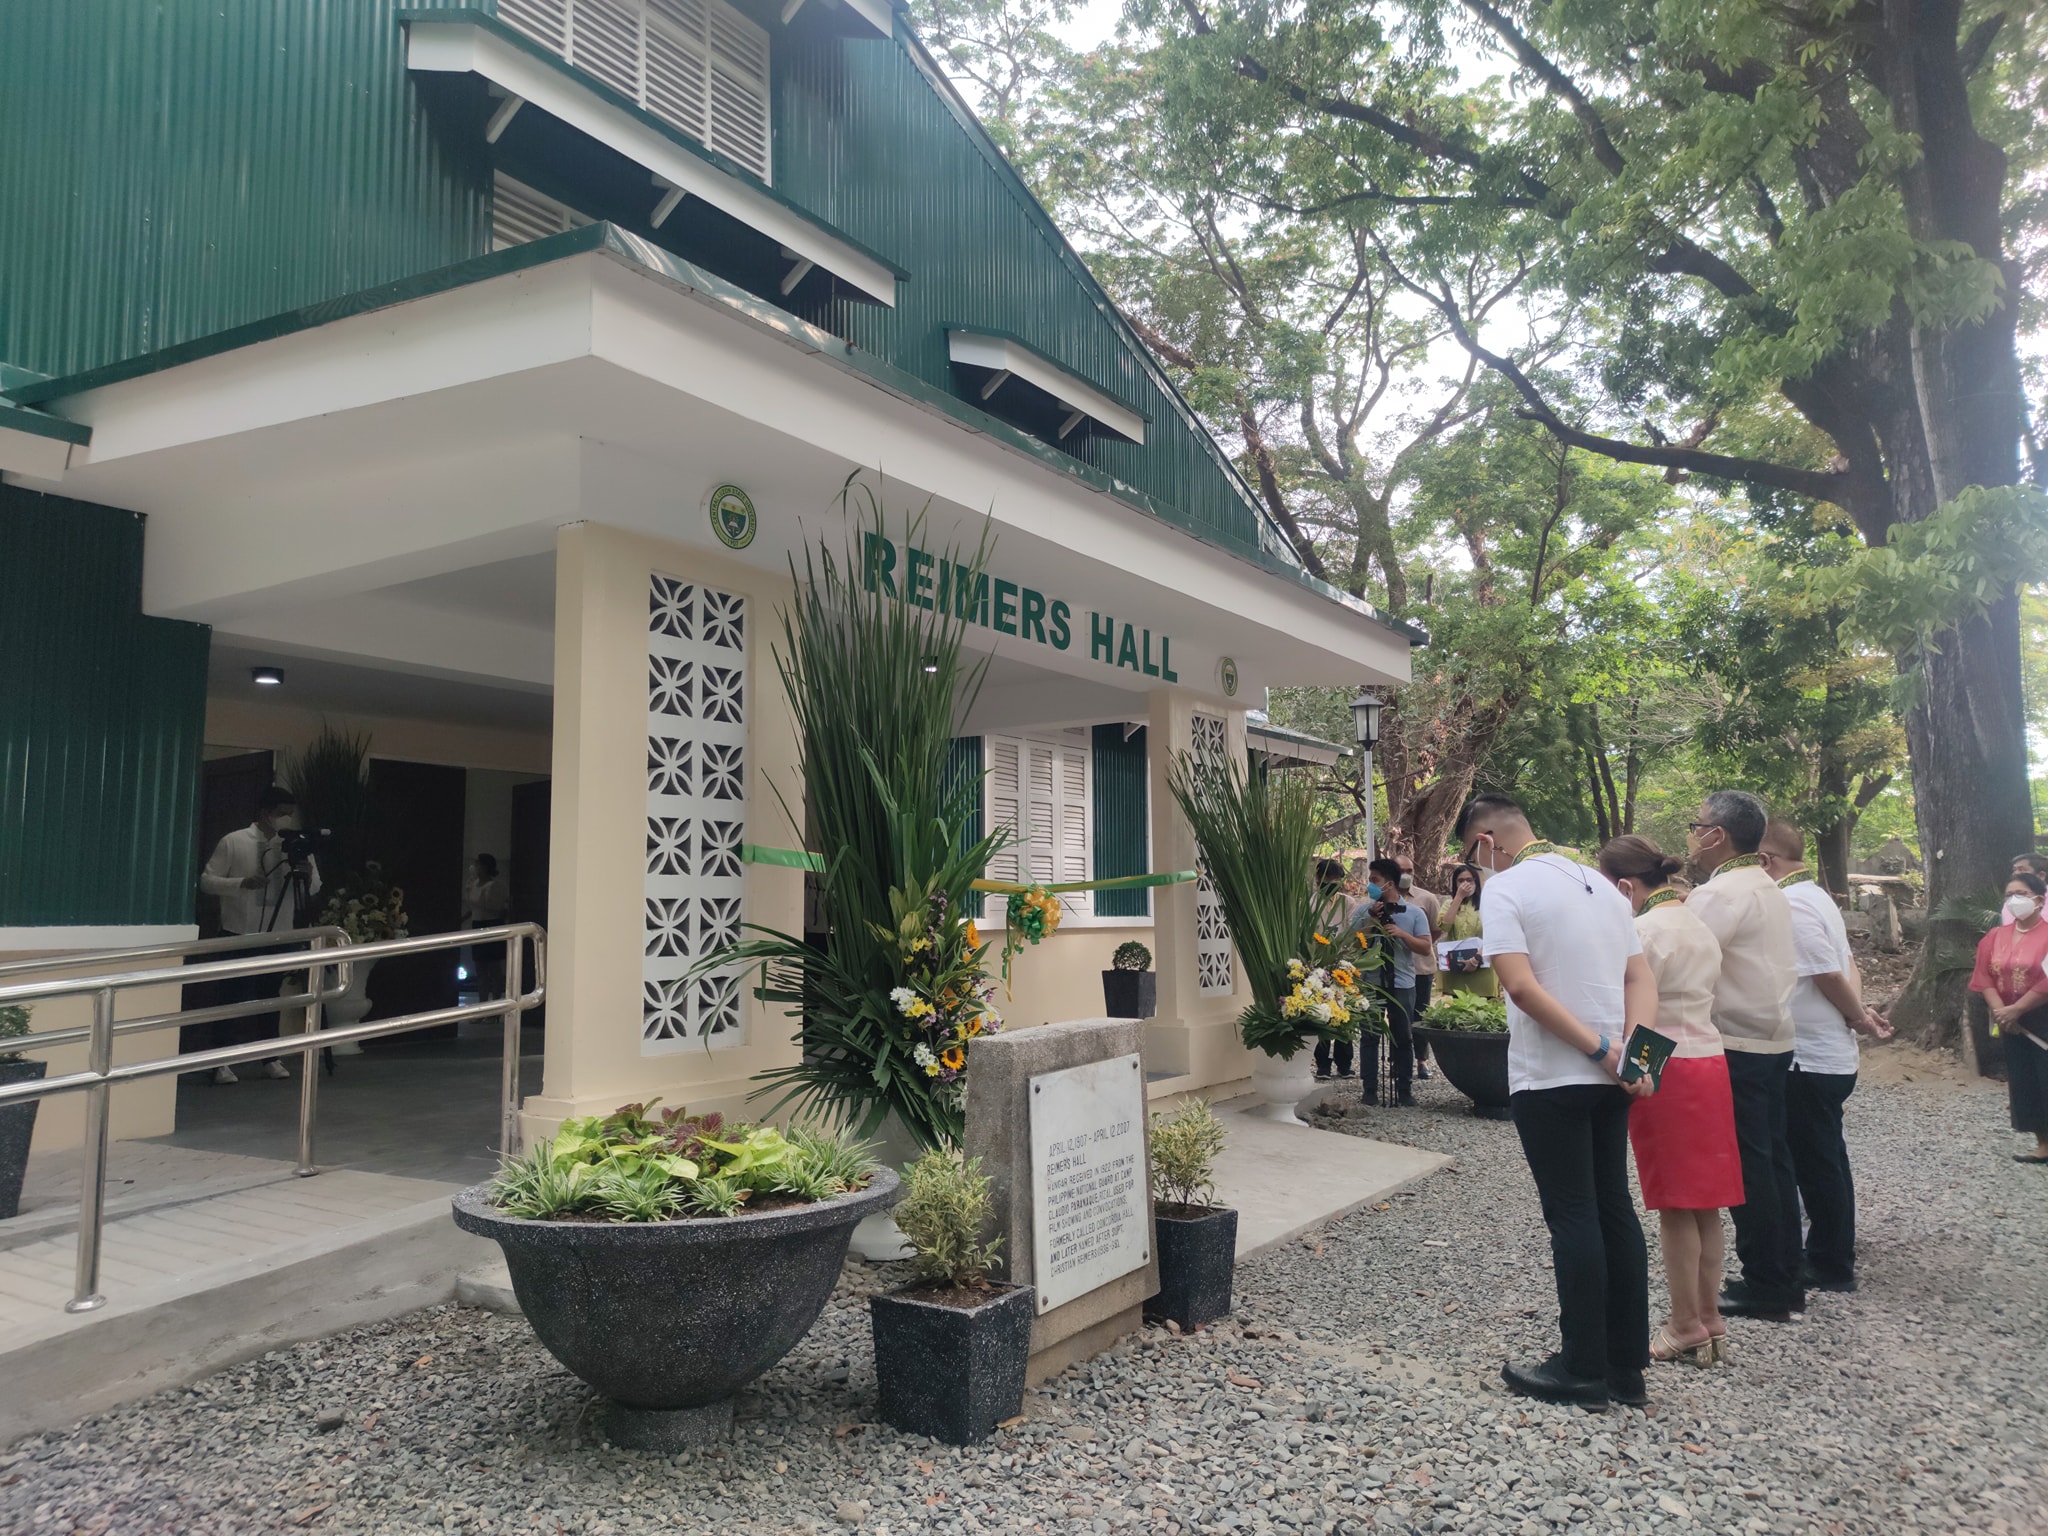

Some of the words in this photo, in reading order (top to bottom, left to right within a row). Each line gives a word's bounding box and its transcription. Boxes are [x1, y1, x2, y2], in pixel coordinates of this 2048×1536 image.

[864, 531, 1071, 650] REIMERS
[1091, 611, 1178, 683] HALL
[1049, 1141, 1066, 1157] APRIL
[1094, 1127, 1109, 1142] APRIL
[1072, 1153, 1086, 1167] HALL
[1047, 1177, 1068, 1192] HANGAR
[1069, 1168, 1093, 1185] RECEIVED
[1093, 1167, 1099, 1177] IN
[1112, 1158, 1125, 1169] FROM
[1125, 1153, 1134, 1165] THE
[1048, 1188, 1075, 1207] PHILIPPINE
[1076, 1180, 1097, 1195] NATIONAL
[1098, 1174, 1113, 1188] GUARD
[1114, 1171, 1120, 1182] AT
[1121, 1167, 1133, 1180] CAMP
[1048, 1203, 1069, 1220] CLAUDIO
[1125, 1179, 1134, 1190] FOR
[1048, 1221, 1060, 1234] FILM
[1061, 1212, 1082, 1229] SHOWING
[1083, 1208, 1092, 1220] AND
[1049, 1229, 1075, 1249] FORMERLY
[1076, 1222, 1096, 1239] CALLED
[1096, 1212, 1122, 1230] CONCORDIA
[1123, 1208, 1134, 1218] HALL
[1050, 1250, 1061, 1264] AND
[1061, 1243, 1078, 1259] LATER
[1078, 1236, 1095, 1250] NAMED
[1095, 1229, 1111, 1243] AFTER
[1050, 1258, 1076, 1278] CHRISTIAN
